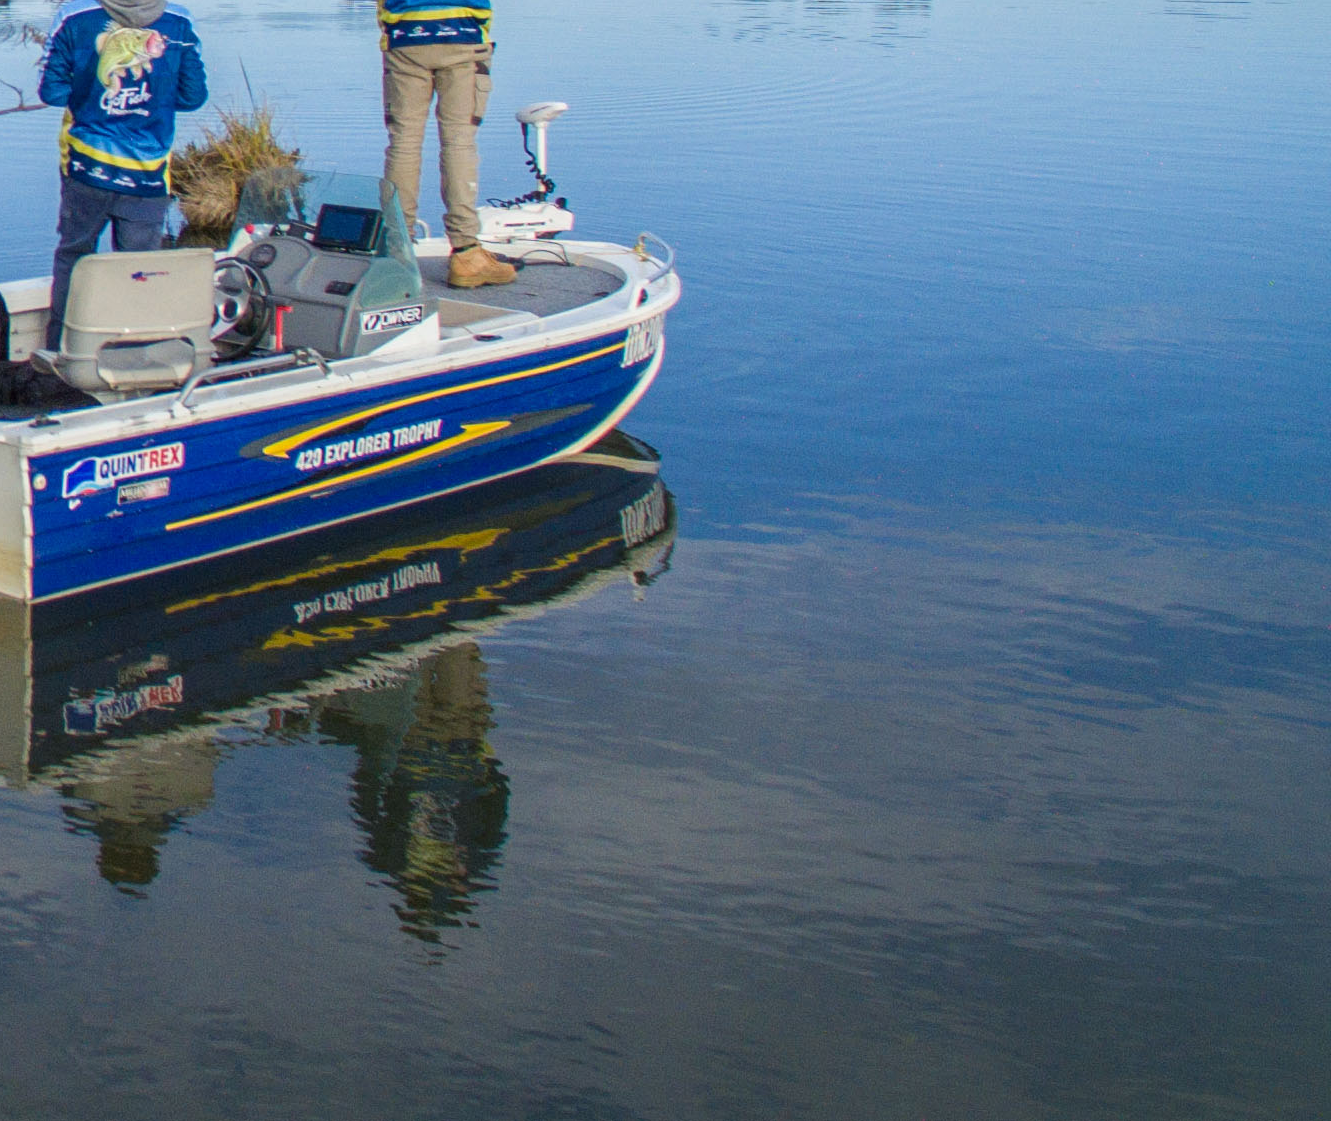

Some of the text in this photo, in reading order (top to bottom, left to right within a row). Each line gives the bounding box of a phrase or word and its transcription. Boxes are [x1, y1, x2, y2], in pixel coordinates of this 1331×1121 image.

[381, 307, 420, 326] OWNER
[99, 445, 181, 479] QUINTREX
[295, 419, 443, 471] 420 EXPLORER TROPHY
